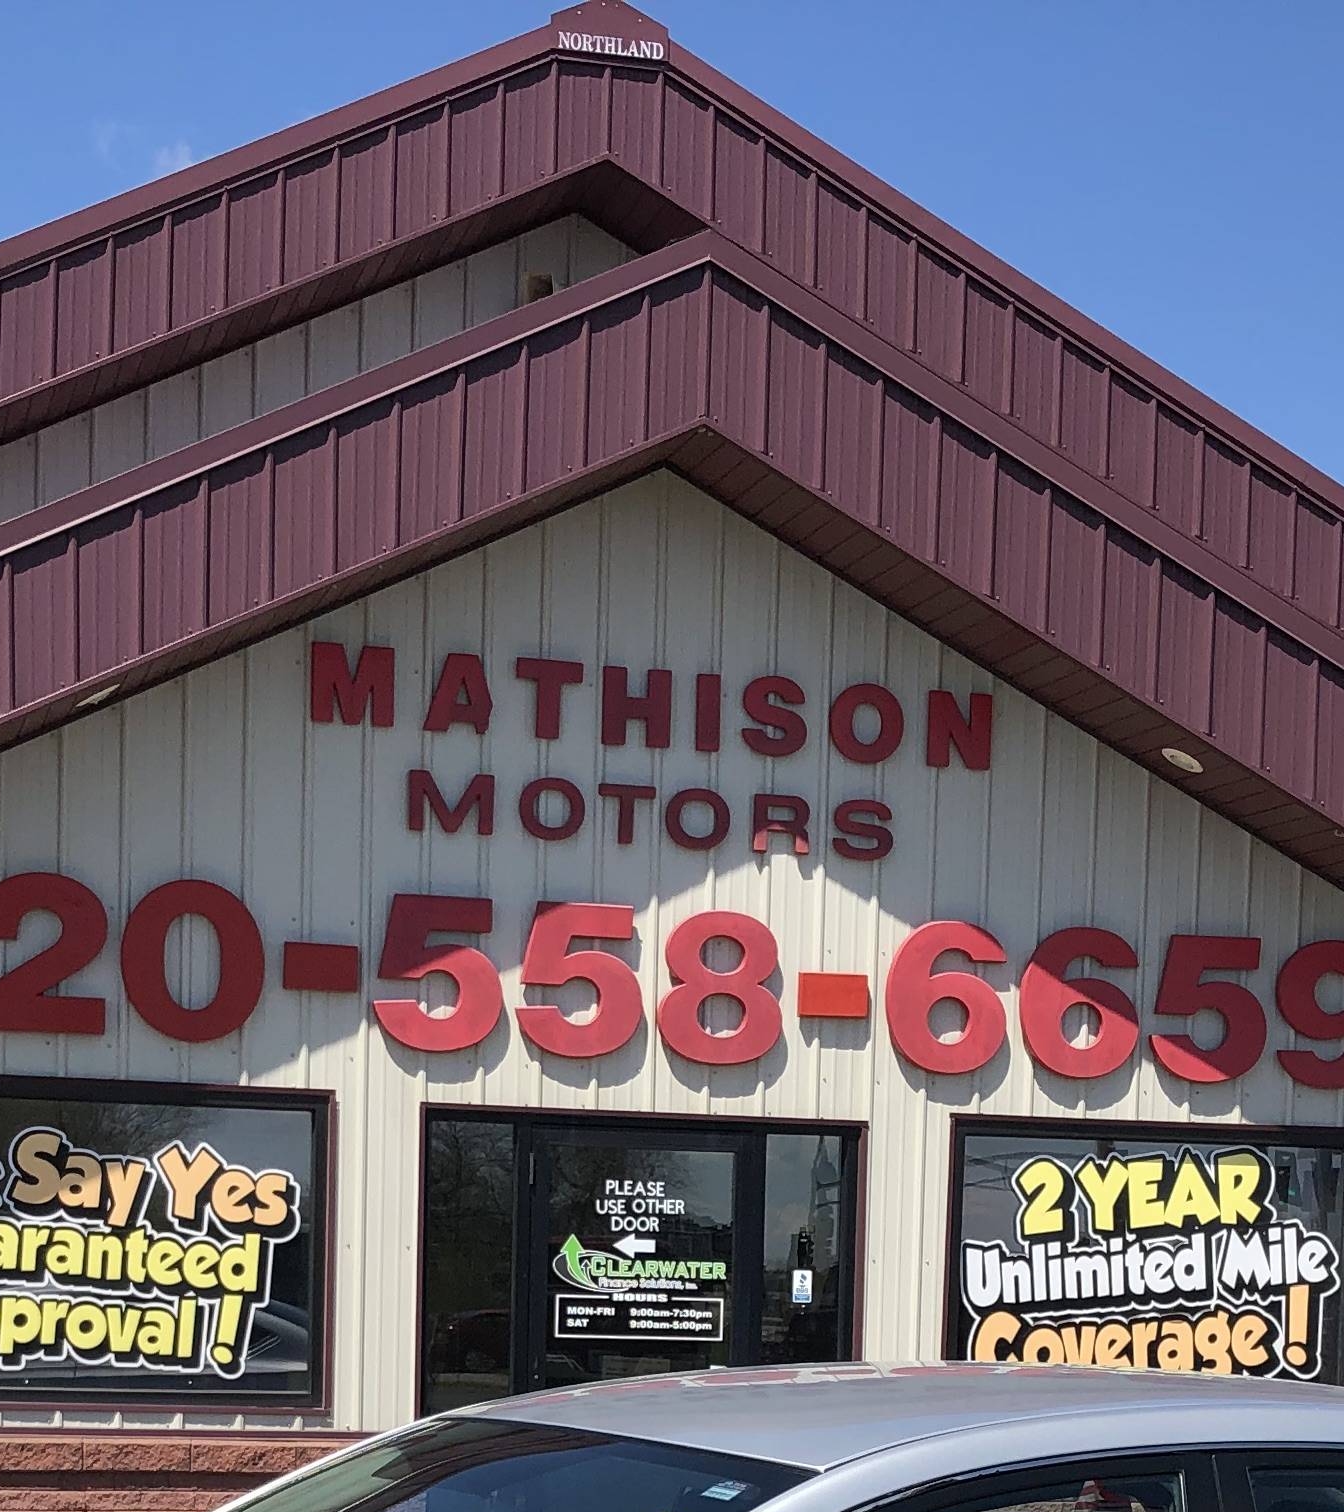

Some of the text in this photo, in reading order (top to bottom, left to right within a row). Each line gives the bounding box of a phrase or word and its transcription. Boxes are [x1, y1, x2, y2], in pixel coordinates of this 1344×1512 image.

[558, 31, 664, 60] NORTHLAND
[311, 641, 993, 770] MATHISON
[407, 769, 894, 861] MOTORS
[11, 1130, 147, 1228] Say
[158, 1144, 292, 1228] Yes
[605, 1179, 666, 1197] PLEASE
[1016, 1152, 1265, 1237] 2 YEAR
[595, 1199, 685, 1215] USE OTHER
[611, 1217, 660, 1232] DOOR
[591, 1257, 727, 1280] CLEARWATER
[964, 1227, 1332, 1309] Unlimited Mile
[598, 1277, 638, 1289] Finance
[612, 1293, 669, 1303] HOURS
[566, 1306, 713, 1320] MON-FRI 9:00am-7:30pm
[566, 1319, 713, 1331] SAT 9:00am-5:00pm
